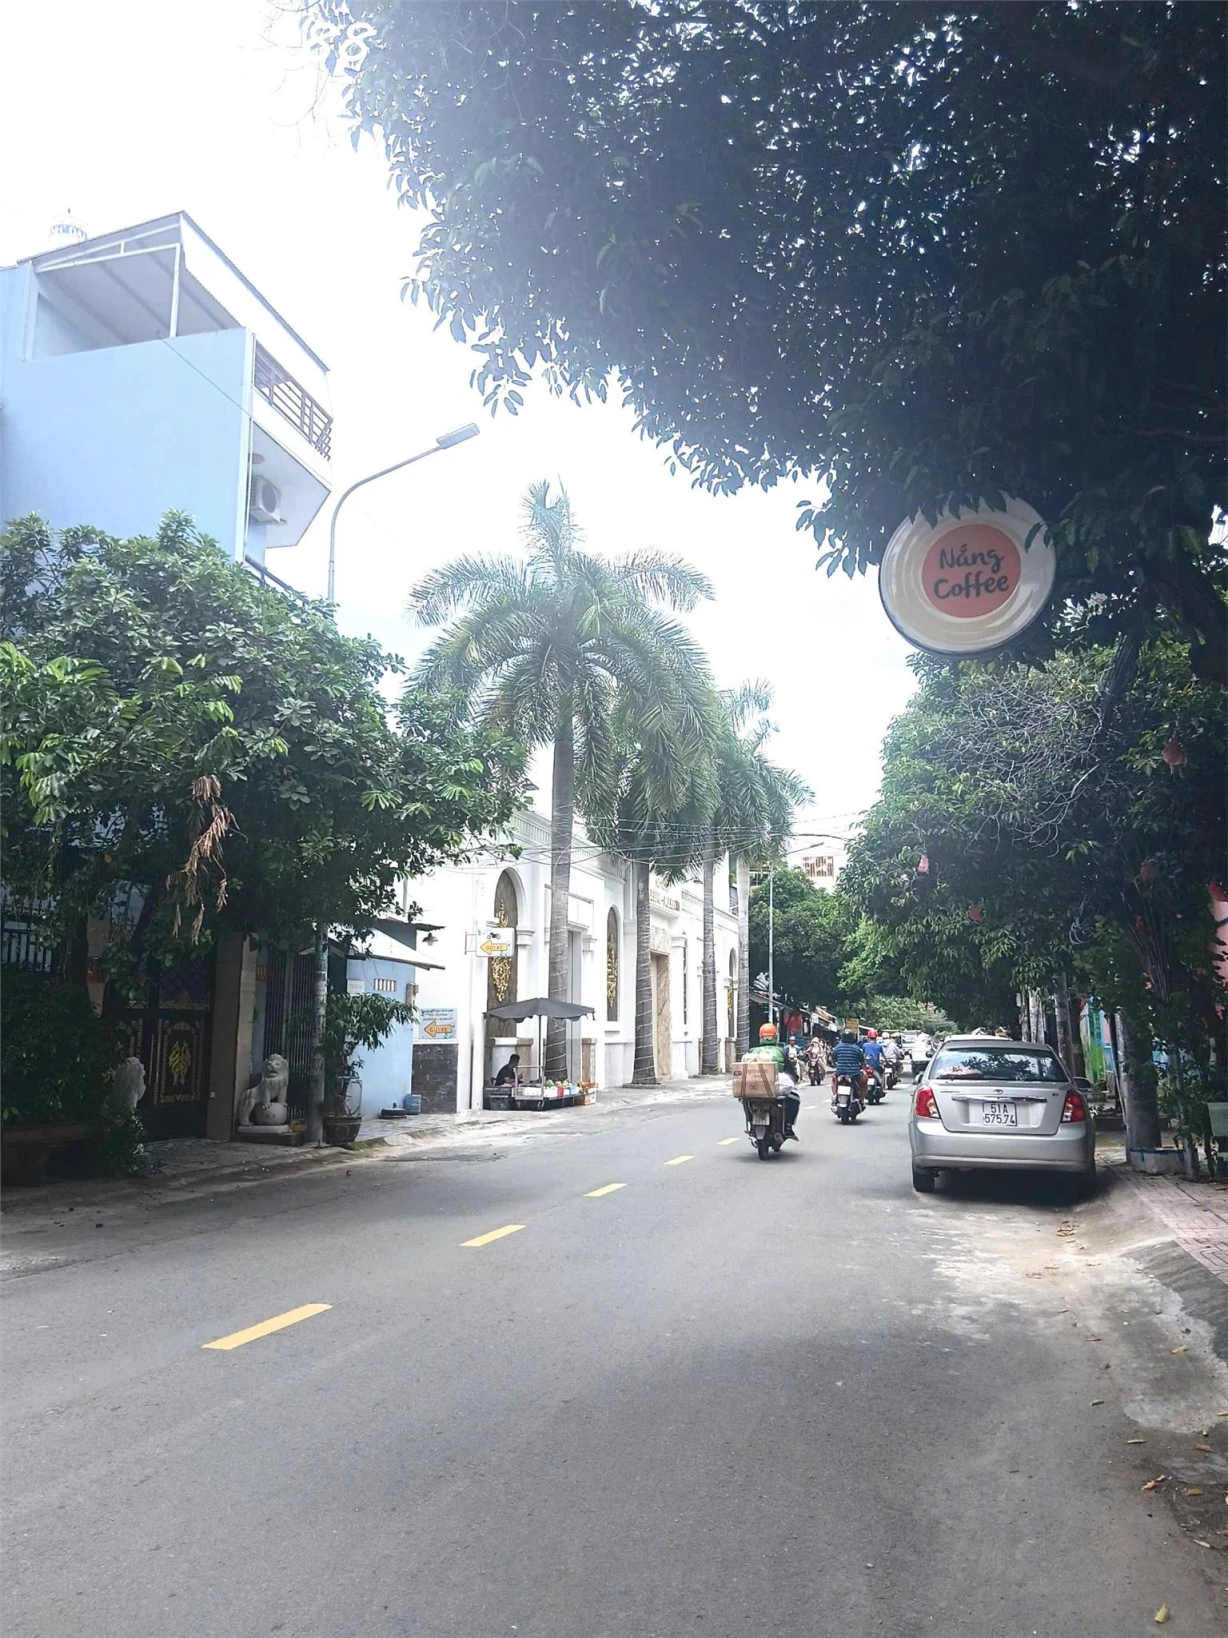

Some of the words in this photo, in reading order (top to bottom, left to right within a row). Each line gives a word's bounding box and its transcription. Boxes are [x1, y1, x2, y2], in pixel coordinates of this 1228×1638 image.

[939, 543, 1004, 572] Nắng
[933, 571, 1010, 599] Coffee
[990, 1103, 1008, 1113] 51A
